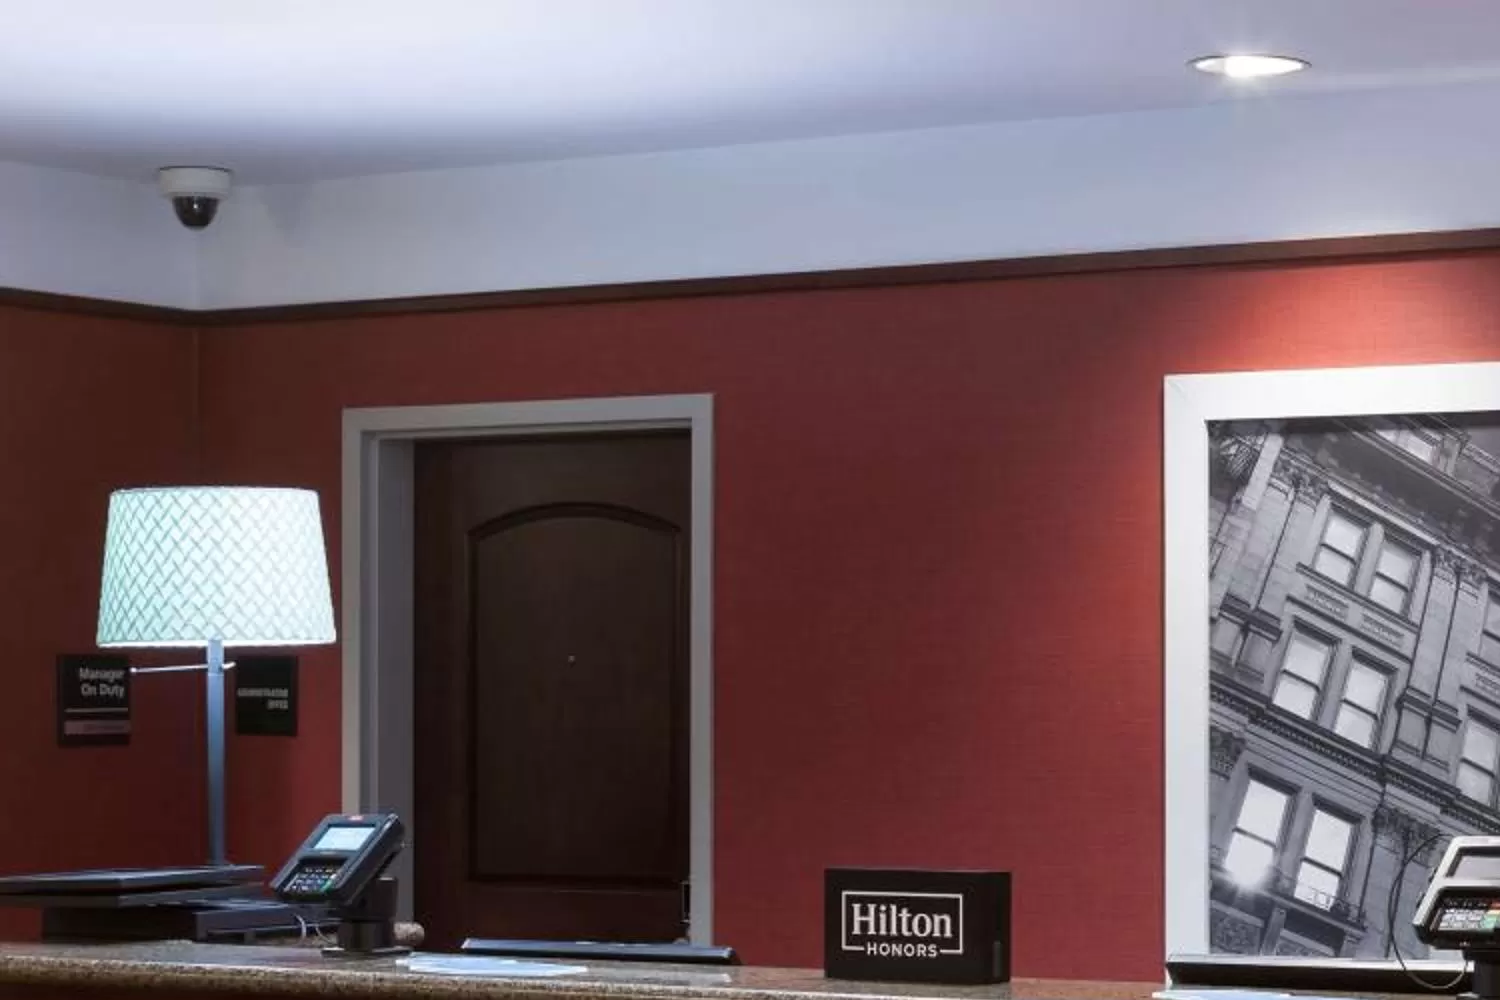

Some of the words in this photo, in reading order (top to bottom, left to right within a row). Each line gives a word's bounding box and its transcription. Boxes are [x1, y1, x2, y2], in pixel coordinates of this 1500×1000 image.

[79, 667, 125, 682] Manager
[81, 683, 97, 696] On
[99, 683, 125, 698] Duty
[851, 903, 953, 938] Hilton
[867, 942, 938, 957] HONORS
